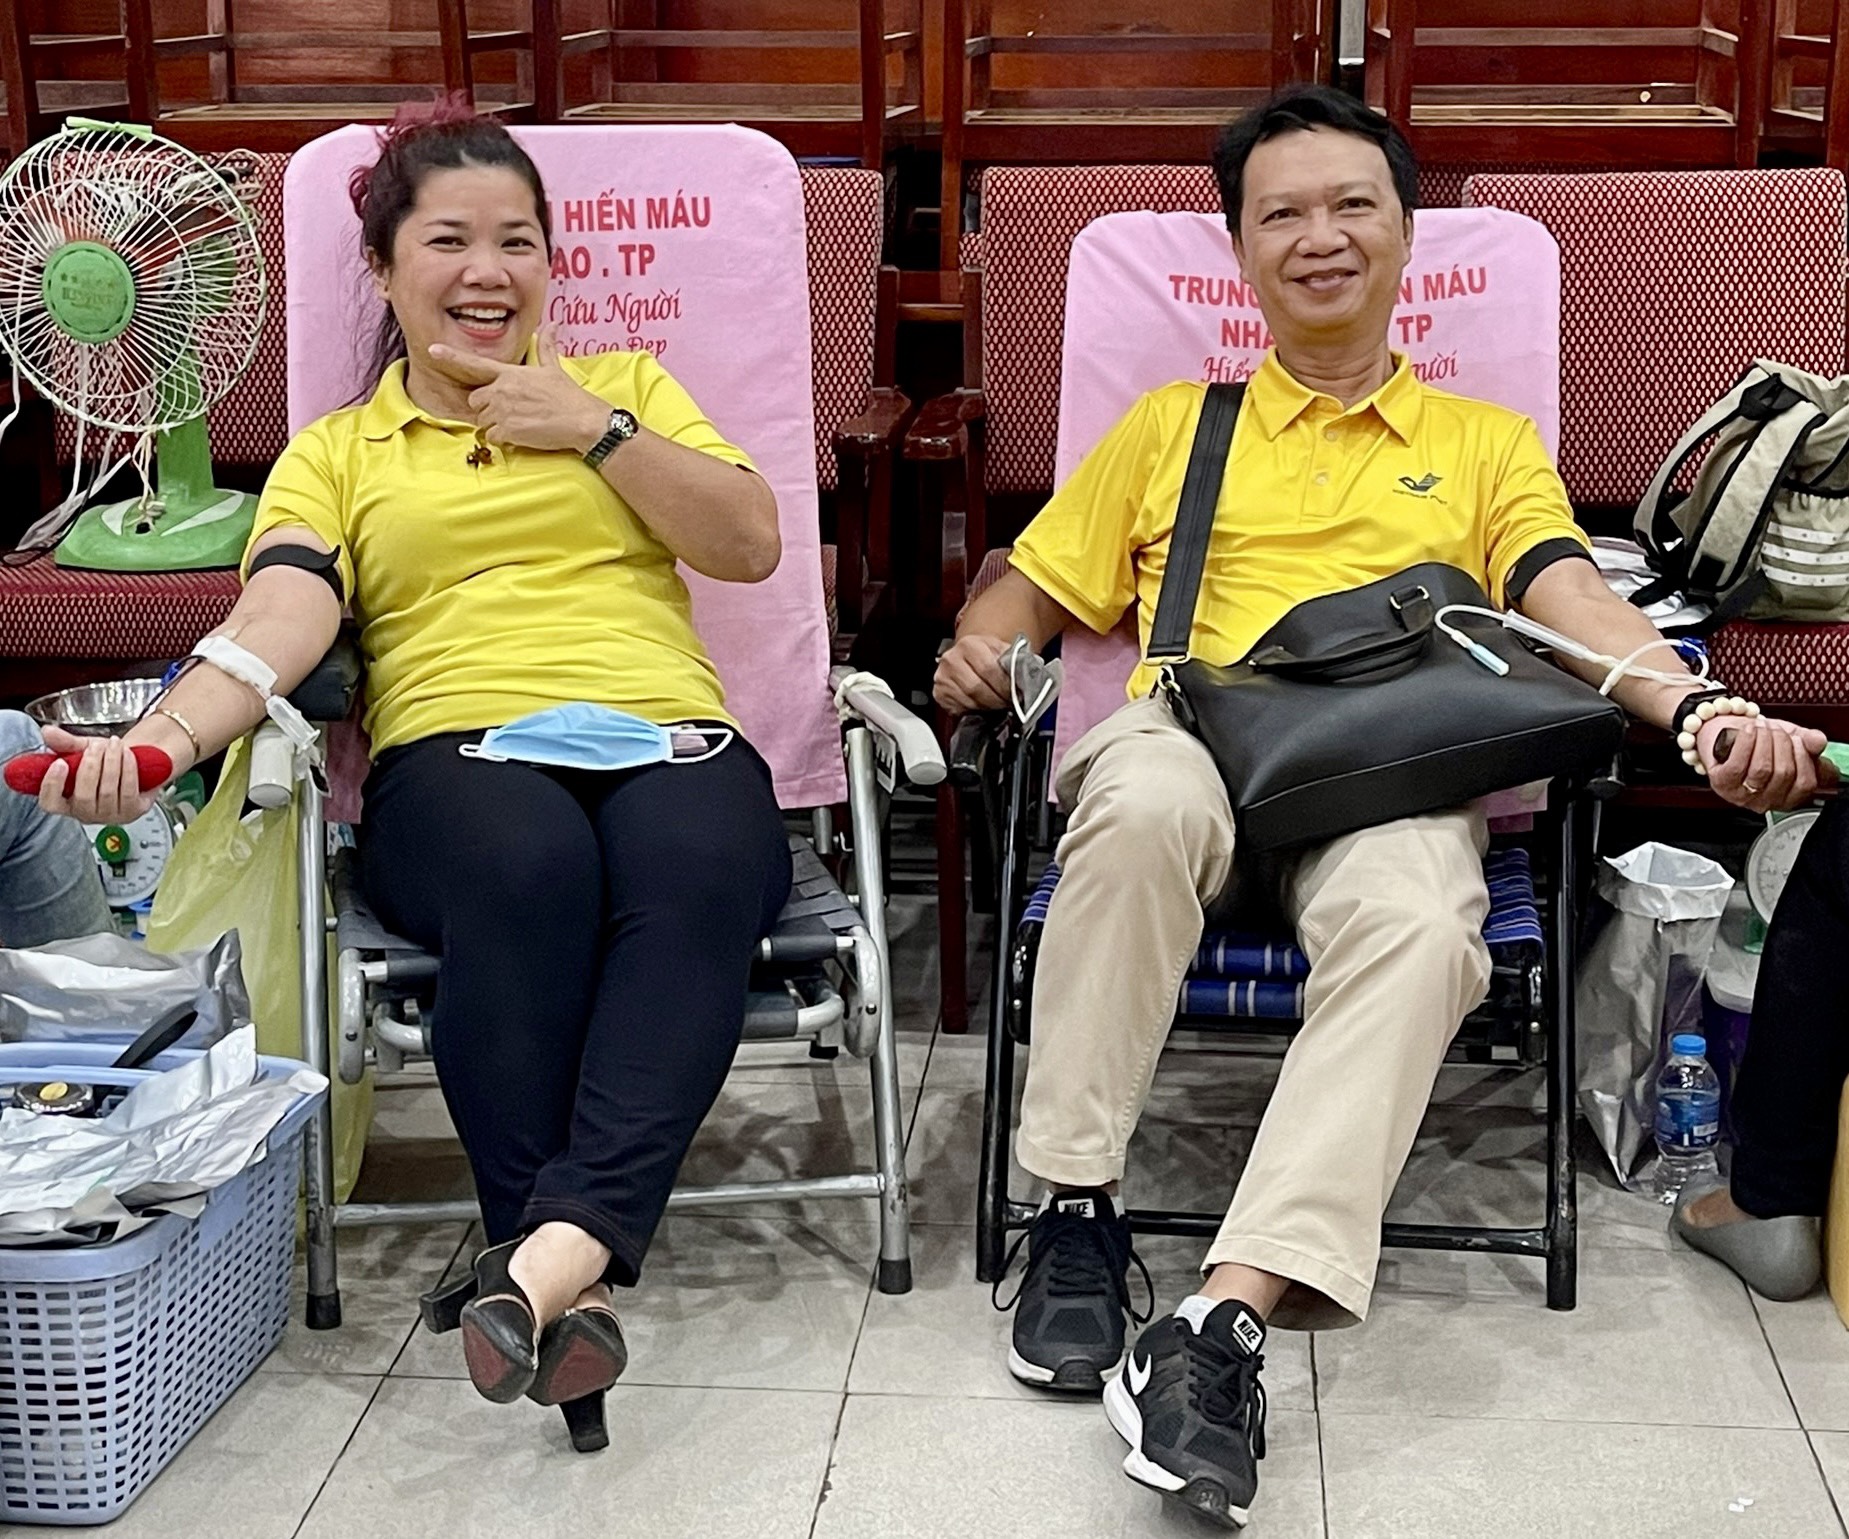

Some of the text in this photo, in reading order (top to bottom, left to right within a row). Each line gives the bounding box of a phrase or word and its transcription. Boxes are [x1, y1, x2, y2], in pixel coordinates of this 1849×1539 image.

[564, 188, 636, 232] HIẾN
[646, 189, 711, 229] MÁU
[550, 245, 592, 286] ẠO
[618, 244, 655, 276] TP
[1423, 263, 1487, 302] MÁU
[550, 288, 682, 334] Cứu Người
[1396, 314, 1433, 344] TP
[1064, 1201, 1090, 1217] NIKE
[1237, 1319, 1260, 1344] NIKE
